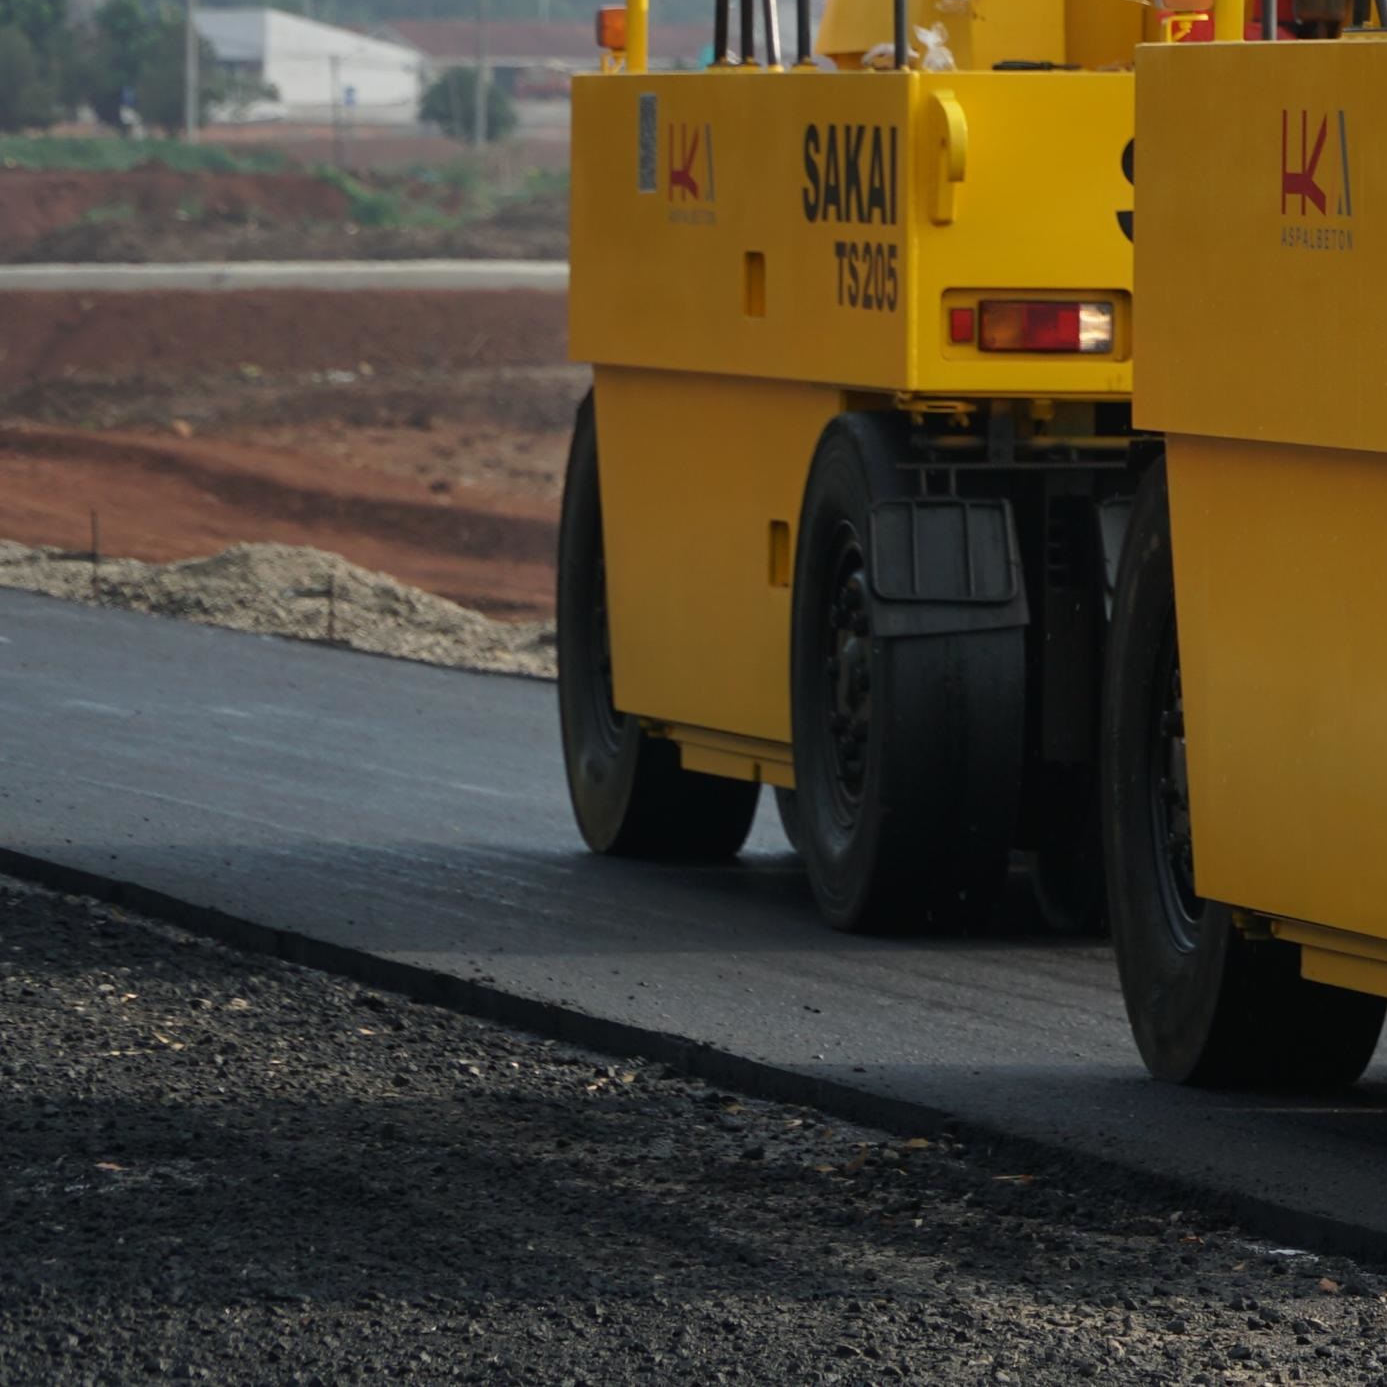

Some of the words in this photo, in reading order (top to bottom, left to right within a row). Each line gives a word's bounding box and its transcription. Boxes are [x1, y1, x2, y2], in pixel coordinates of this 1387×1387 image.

[802, 123, 898, 225] SAKAI
[1280, 226, 1354, 251] ASPALBETON
[834, 241, 898, 313] TS205
